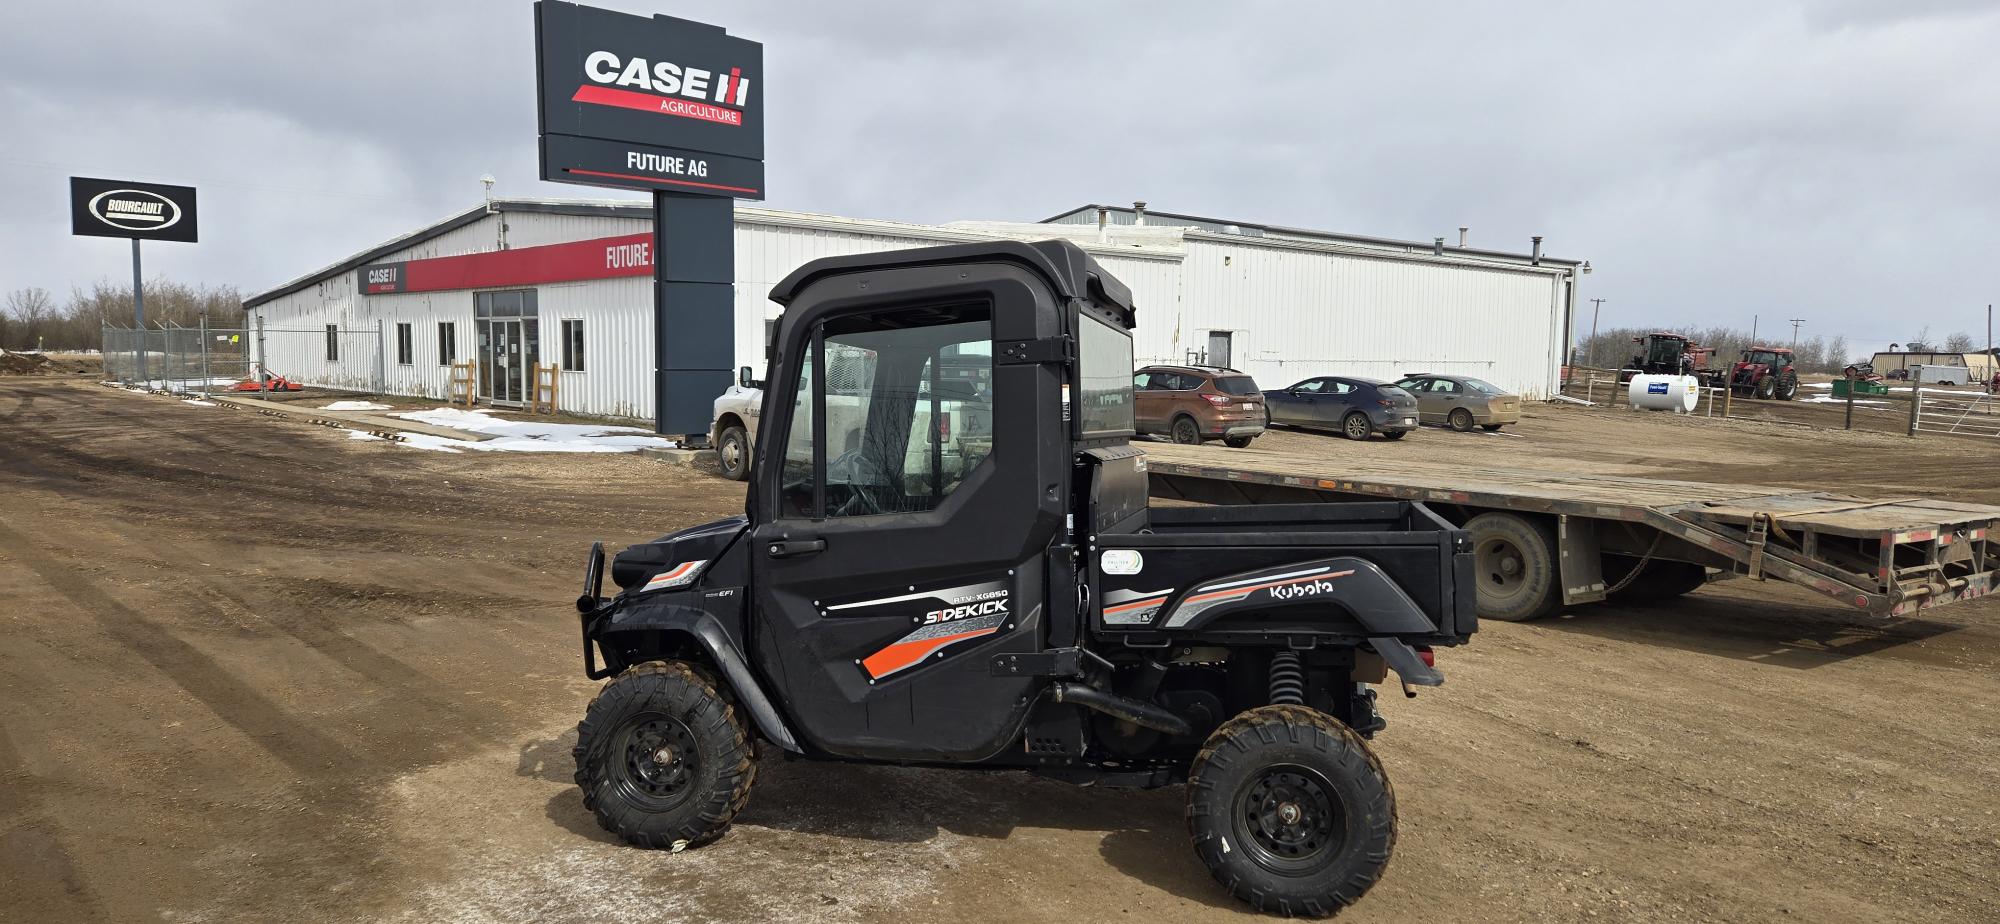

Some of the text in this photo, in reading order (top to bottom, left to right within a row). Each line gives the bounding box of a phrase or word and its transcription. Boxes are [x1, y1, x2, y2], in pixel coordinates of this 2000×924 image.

[584, 50, 711, 99] CASE
[660, 99, 738, 123] AGRICULTURE
[627, 151, 707, 177] FUTURE AG
[107, 198, 164, 215] BOURGAULT
[606, 242, 649, 269] FUTURE
[368, 268, 389, 284] CASE
[953, 589, 1009, 604] RTV-XG850
[1269, 579, 1334, 600] Kubota
[923, 598, 1009, 625] SIDEKICK
